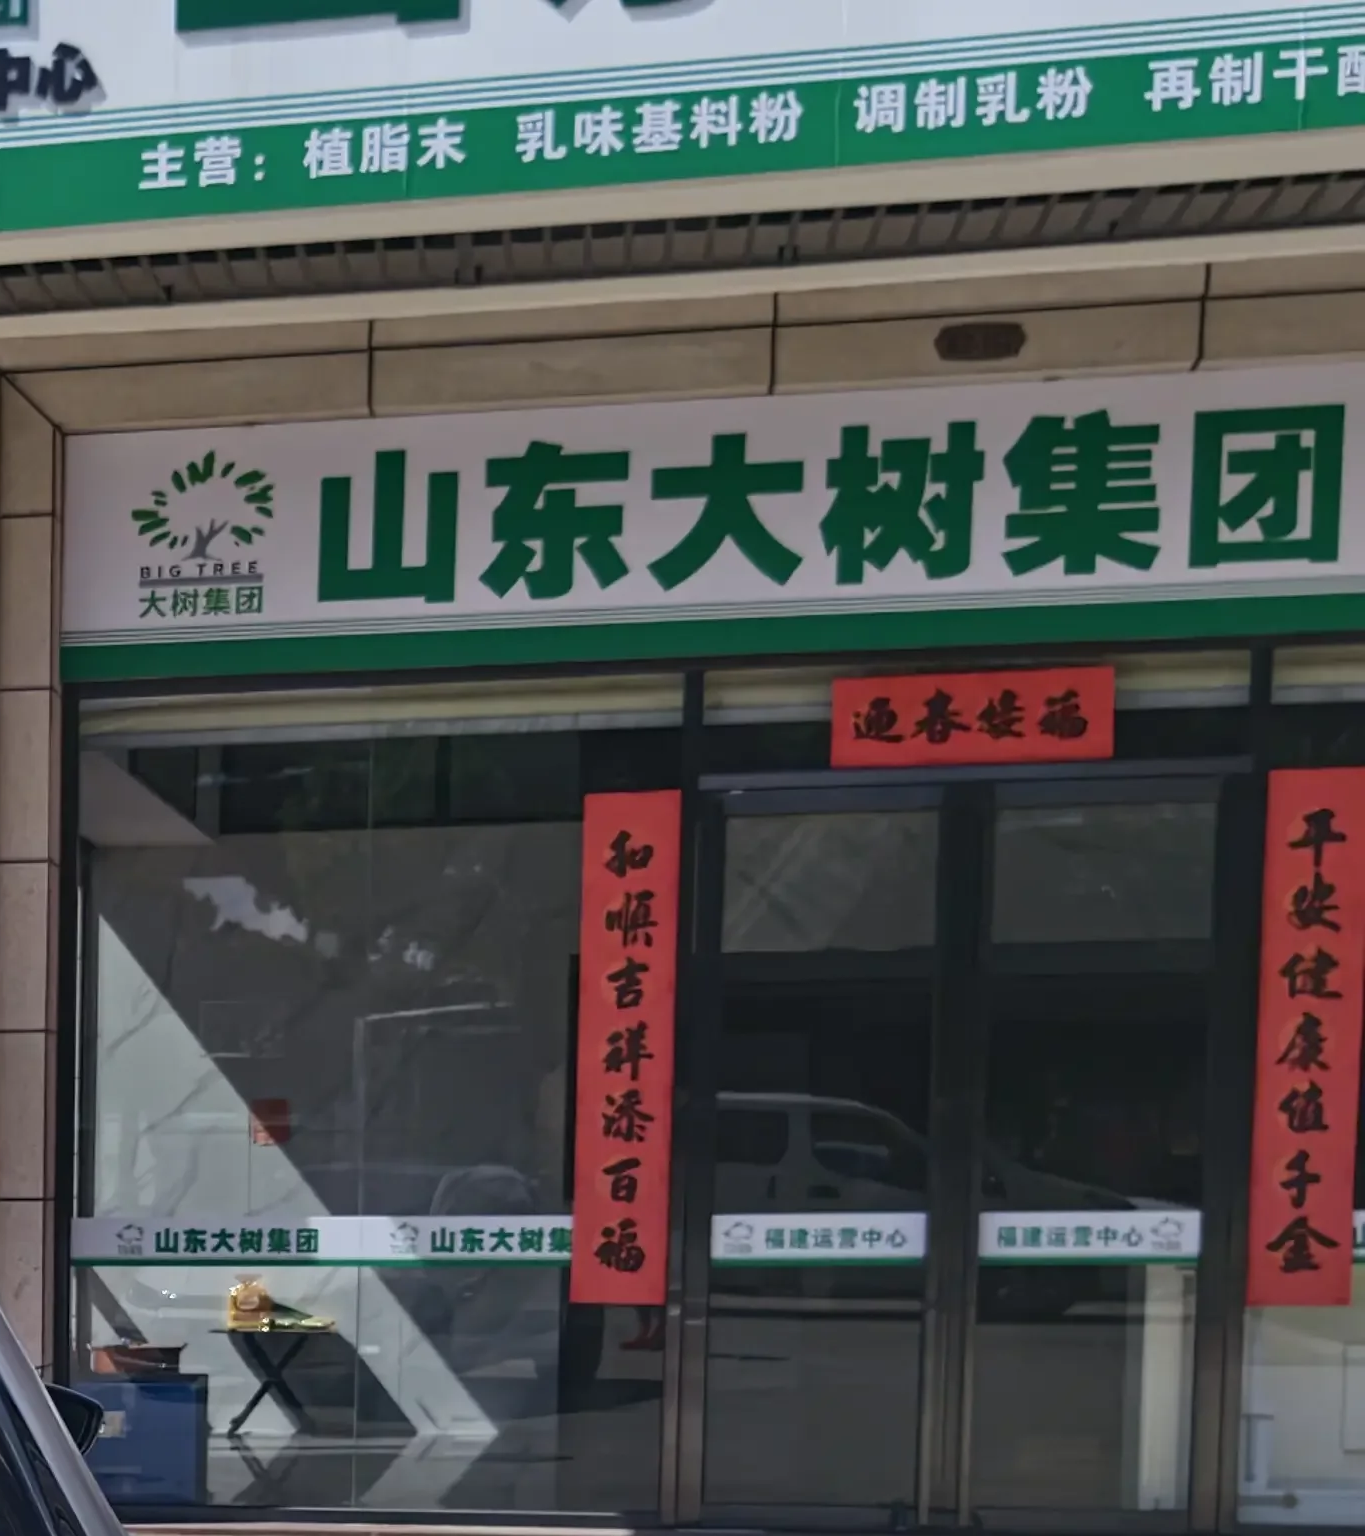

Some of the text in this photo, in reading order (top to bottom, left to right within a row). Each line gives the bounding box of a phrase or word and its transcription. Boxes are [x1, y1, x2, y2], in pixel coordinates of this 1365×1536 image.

[303, 118, 467, 179] 植脂末
[515, 90, 803, 163] 乳味基料粉
[855, 65, 1093, 134] 调制乳粉
[318, 404, 1346, 603] 山东大树集团
[140, 561, 258, 579] BIG TREE
[139, 585, 263, 618] 大树集团
[1265, 808, 1346, 1273] 平安健康值千金
[155, 1226, 319, 1254] 山东大树集团
[764, 1226, 908, 1250] 福建运营中心
[996, 1224, 1144, 1248] 福建运营中心
